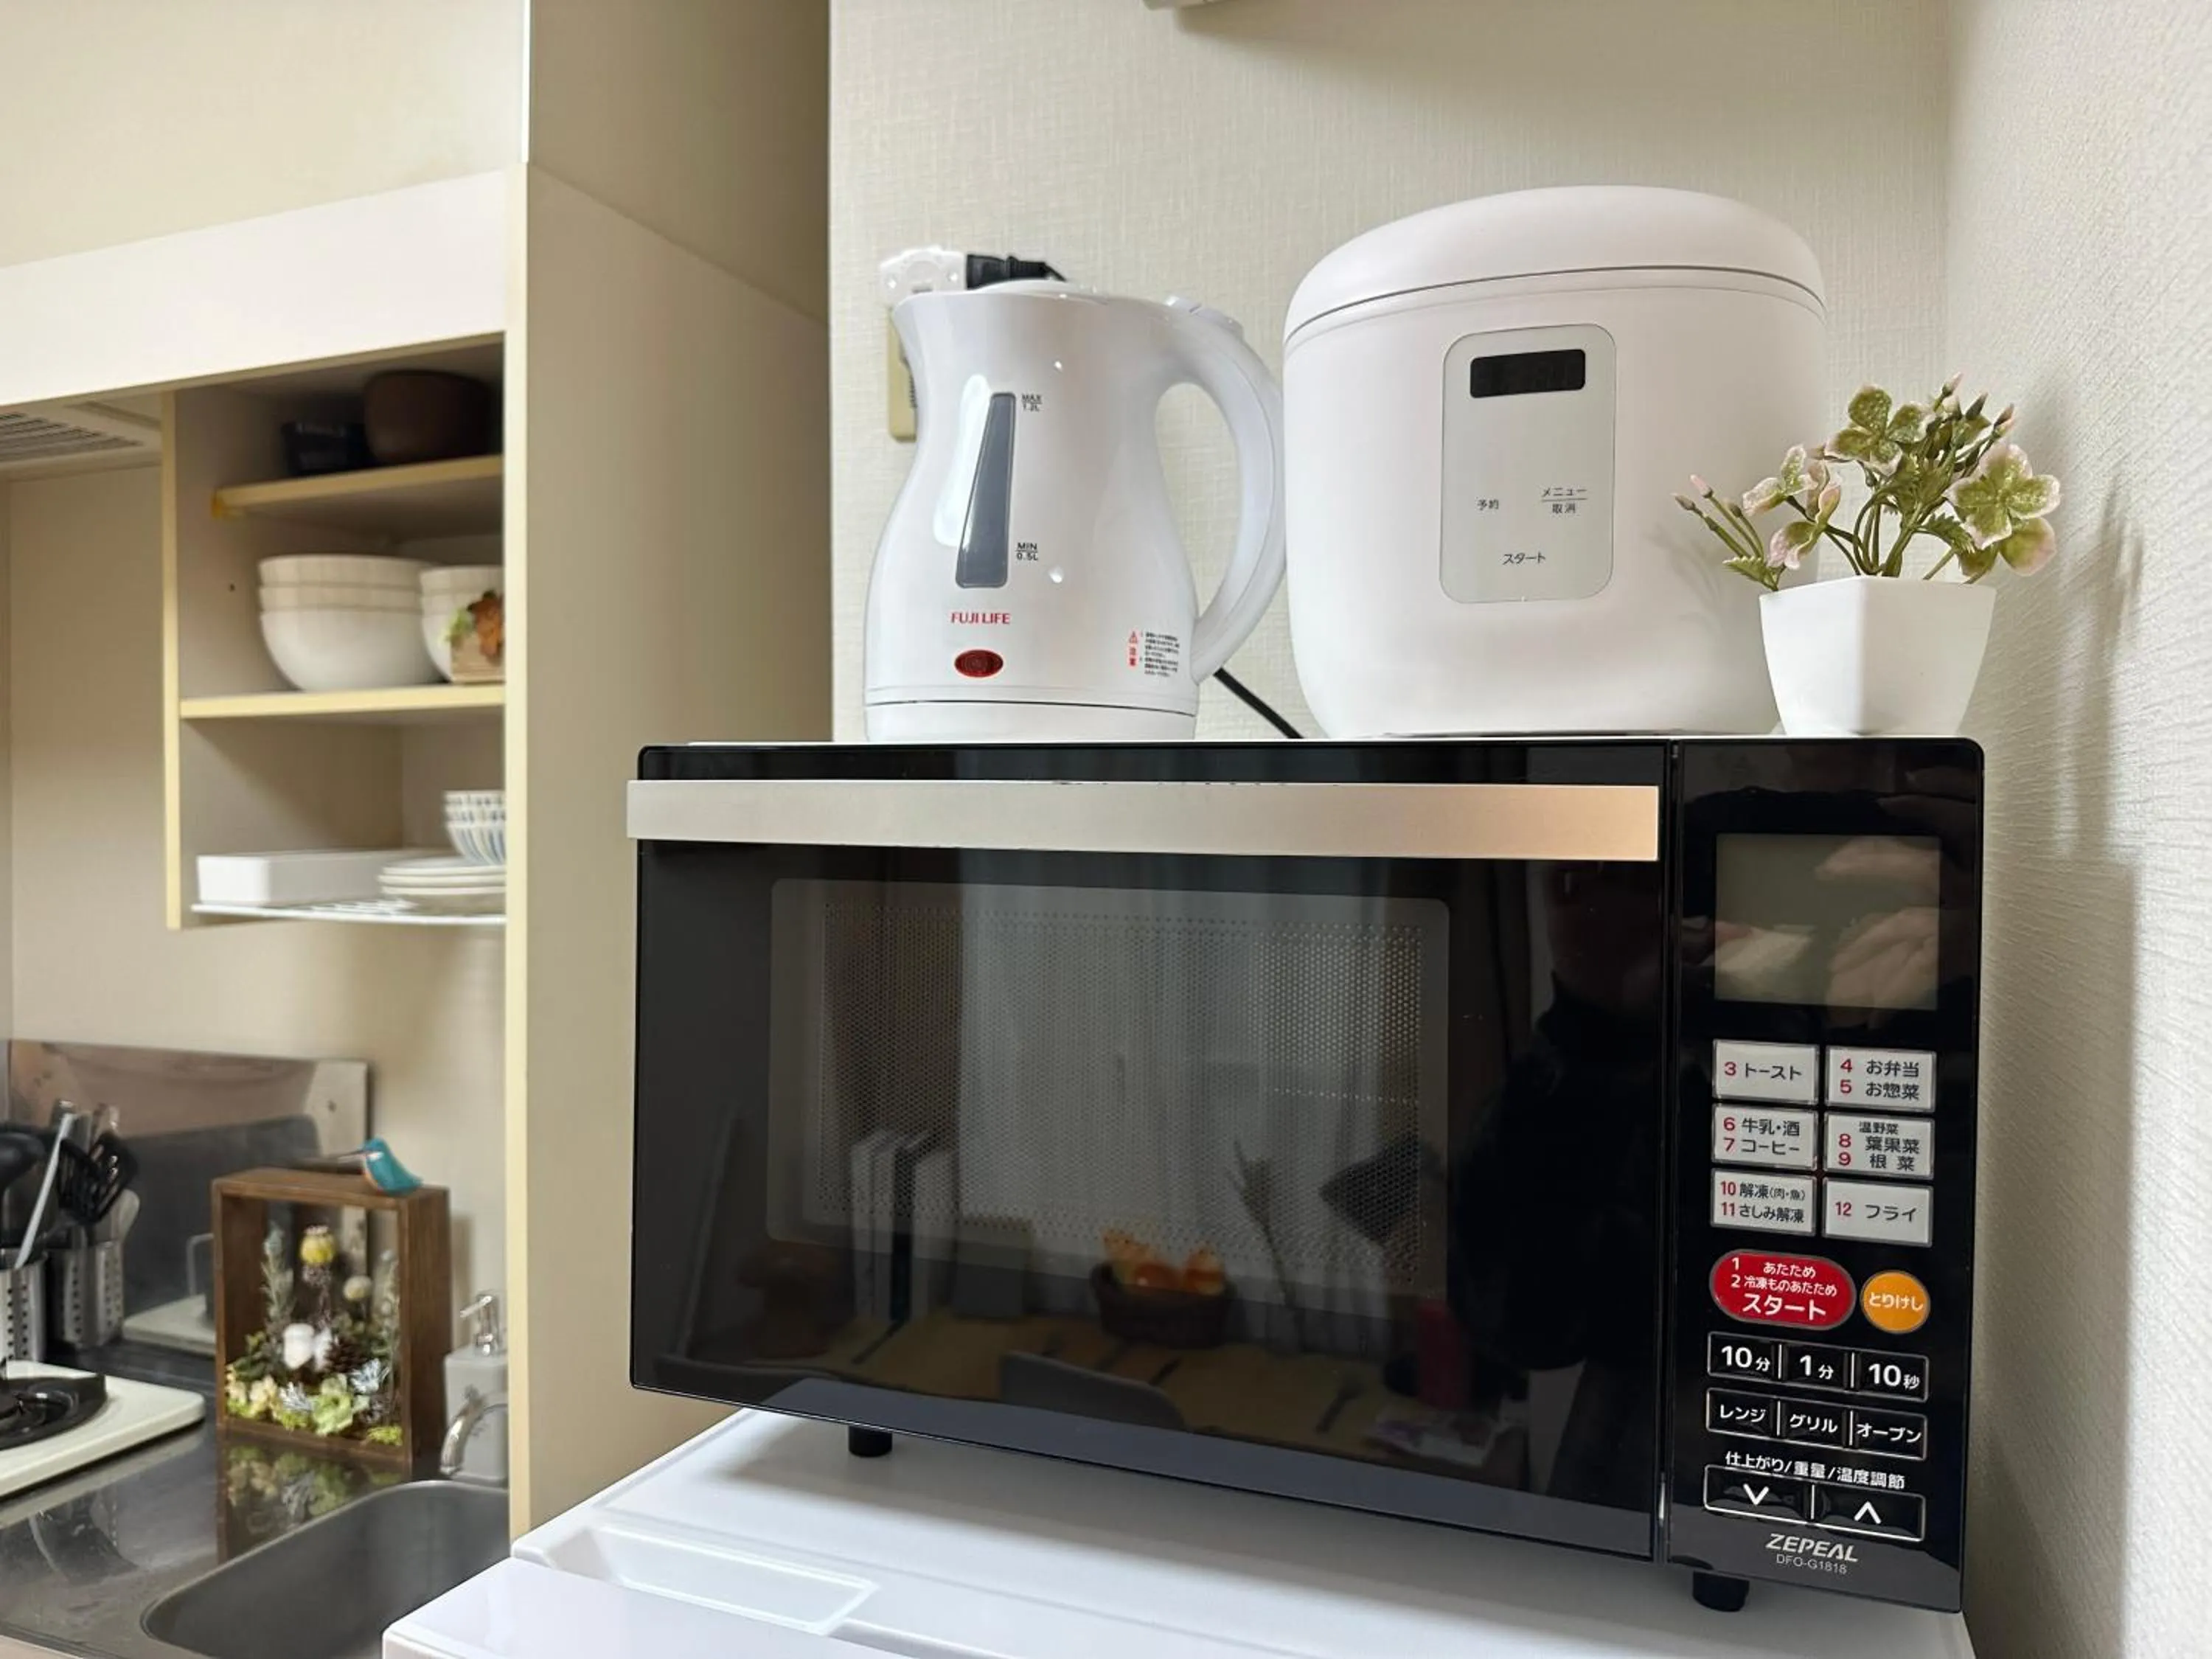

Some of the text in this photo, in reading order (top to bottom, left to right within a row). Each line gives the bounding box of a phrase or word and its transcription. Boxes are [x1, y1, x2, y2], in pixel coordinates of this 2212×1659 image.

[1022, 394, 1042, 403] MAX
[1541, 487, 1587, 498] メニュー
[1477, 499, 1499, 511] 予約
[1552, 503, 1576, 514] 取消
[1018, 542, 1037, 550] MIN
[1017, 552, 1038, 561] 0.5L
[1503, 552, 1546, 565] スタート
[1724, 1062, 1802, 1080] 3 トースト
[1840, 1059, 1919, 1078] 4 お弁当
[1840, 1079, 1919, 1100] 5 お惣菜
[1723, 1117, 1735, 1130] 6
[1860, 1121, 1898, 1135] 温野菜
[1724, 1138, 1800, 1155] 7 コーヒー
[1839, 1133, 1919, 1154] 8 葉果菜
[1839, 1152, 1851, 1166] 9
[1720, 1180, 1736, 1196] 10
[1721, 1202, 1804, 1223] 11 さしみ解凍
[1836, 1203, 1917, 1222] 12 フライ
[1732, 1257, 1816, 1279] 1 あたため
[1731, 1275, 1837, 1296] 2 冷凍ものあたため
[1742, 1293, 1826, 1321] スタート
[1868, 1292, 1924, 1311] とりけし
[1719, 1404, 1767, 1422] レンジ
[1790, 1413, 1837, 1433] グリル
[1766, 1533, 1858, 1562] ZEPEAL
[1776, 1554, 1847, 1574] DFO-G1818
